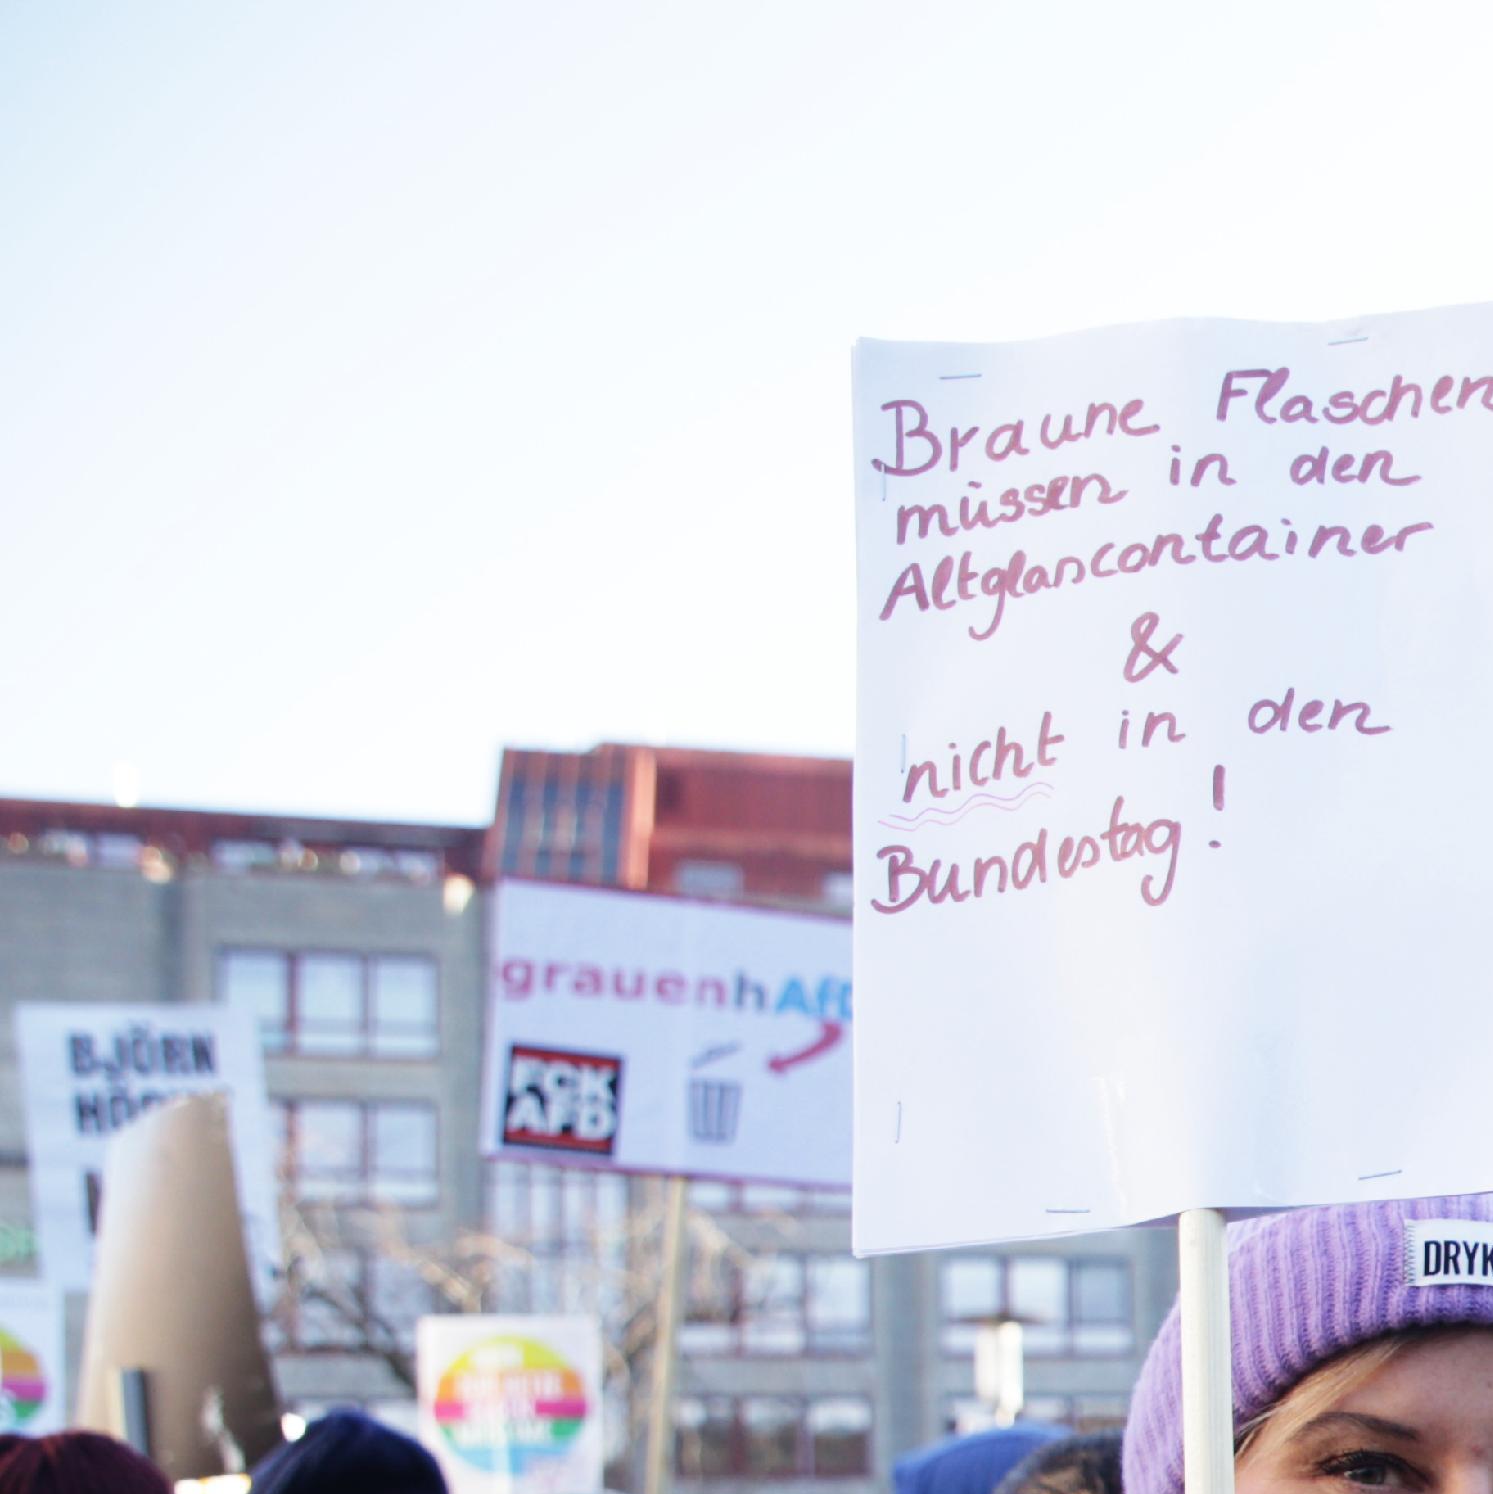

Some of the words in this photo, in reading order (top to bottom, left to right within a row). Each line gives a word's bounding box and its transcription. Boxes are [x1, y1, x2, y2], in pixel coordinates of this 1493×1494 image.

[870, 398, 1161, 476] Braune
[896, 472, 1130, 545] müssen
[1169, 445, 1237, 489] in
[1288, 445, 1423, 488] den
[878, 513, 1435, 641] Altglascontainer
[1122, 611, 1184, 684] &
[902, 711, 1065, 804] nicht
[1117, 709, 1187, 750] in
[1247, 686, 1393, 735] den
[871, 764, 1227, 914] Bundestag!
[68, 1020, 215, 1077] BJÖRN
[513, 1056, 618, 1100] FCK
[507, 1096, 618, 1140] AFD
